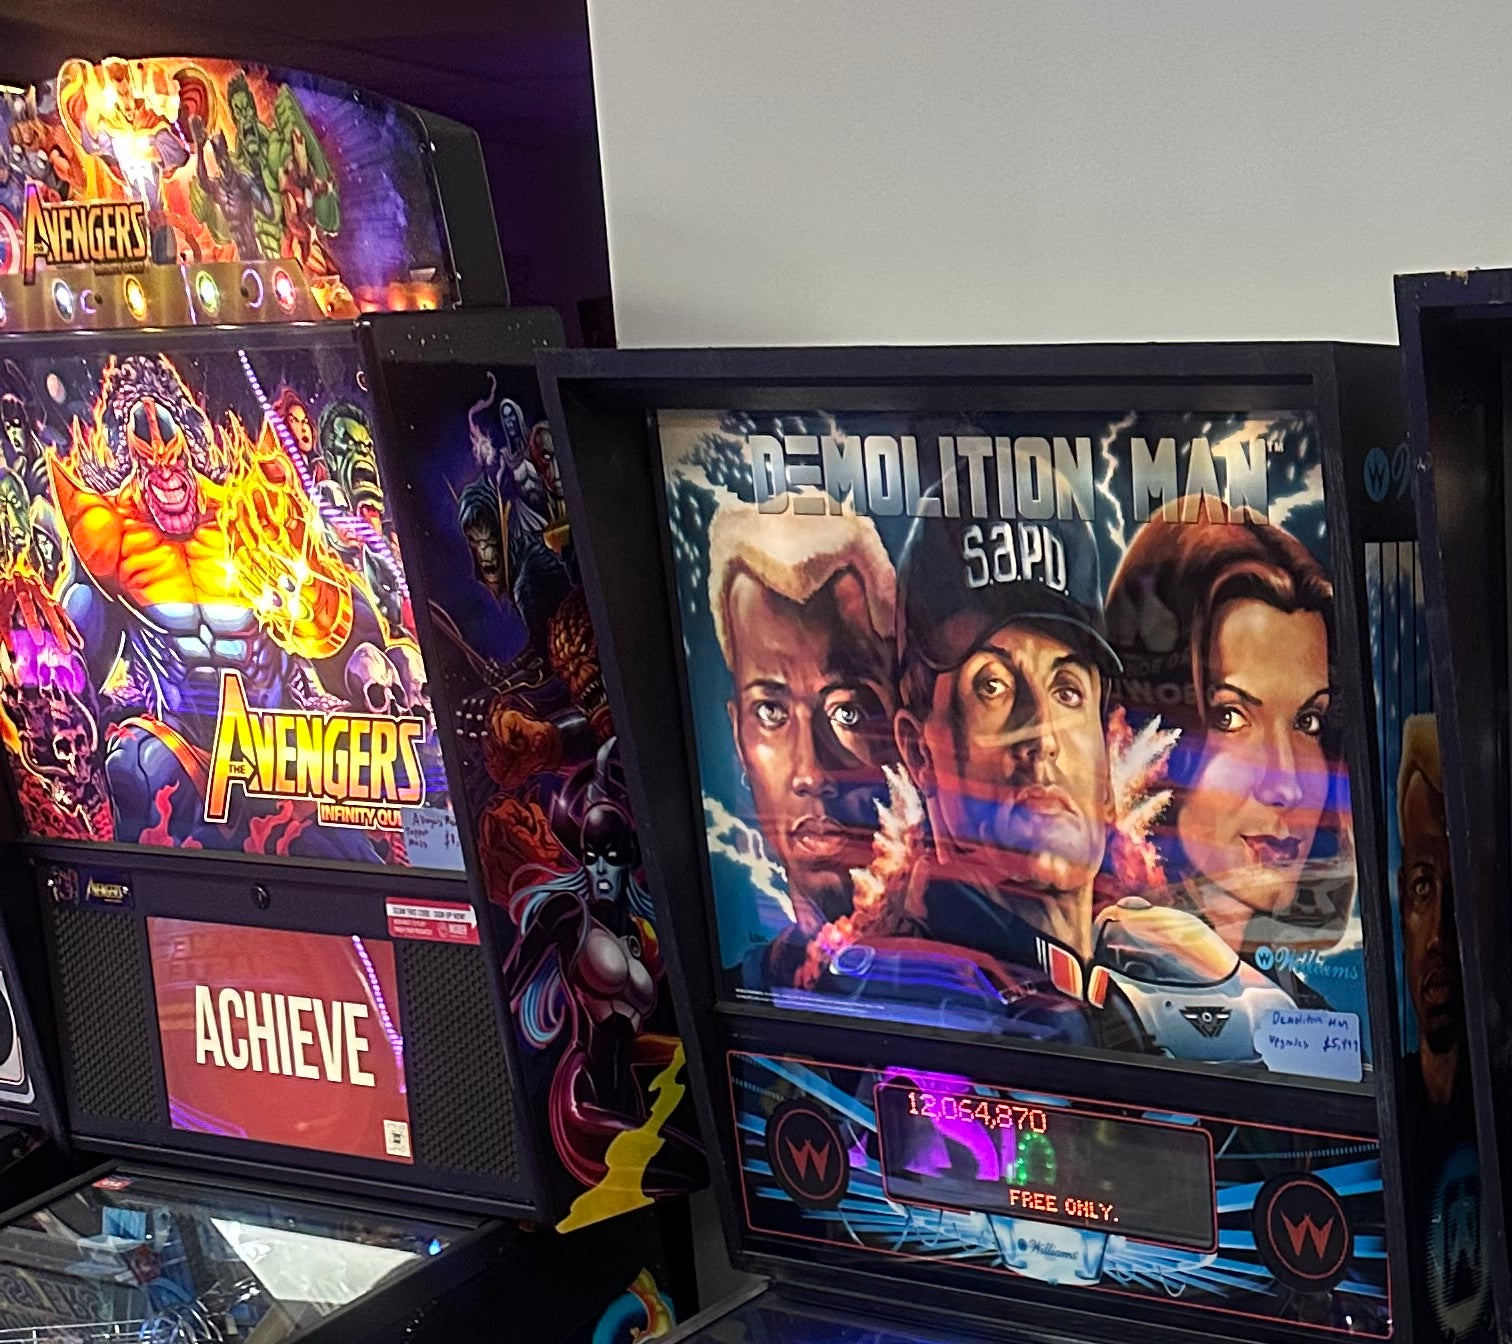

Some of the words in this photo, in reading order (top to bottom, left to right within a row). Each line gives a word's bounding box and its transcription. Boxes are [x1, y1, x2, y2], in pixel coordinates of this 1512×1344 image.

[24, 183, 148, 286] AVENGERS
[746, 433, 1096, 522] DEMOLITION
[1130, 436, 1271, 525] MAN
[204, 669, 427, 823] AVENGERS
[228, 764, 246, 775] THE
[321, 806, 376, 828] INFINITY
[194, 984, 377, 1087] ACHIEVE
[908, 1091, 1047, 1134] 12,064,870
[1009, 1188, 1059, 1213] FREE
